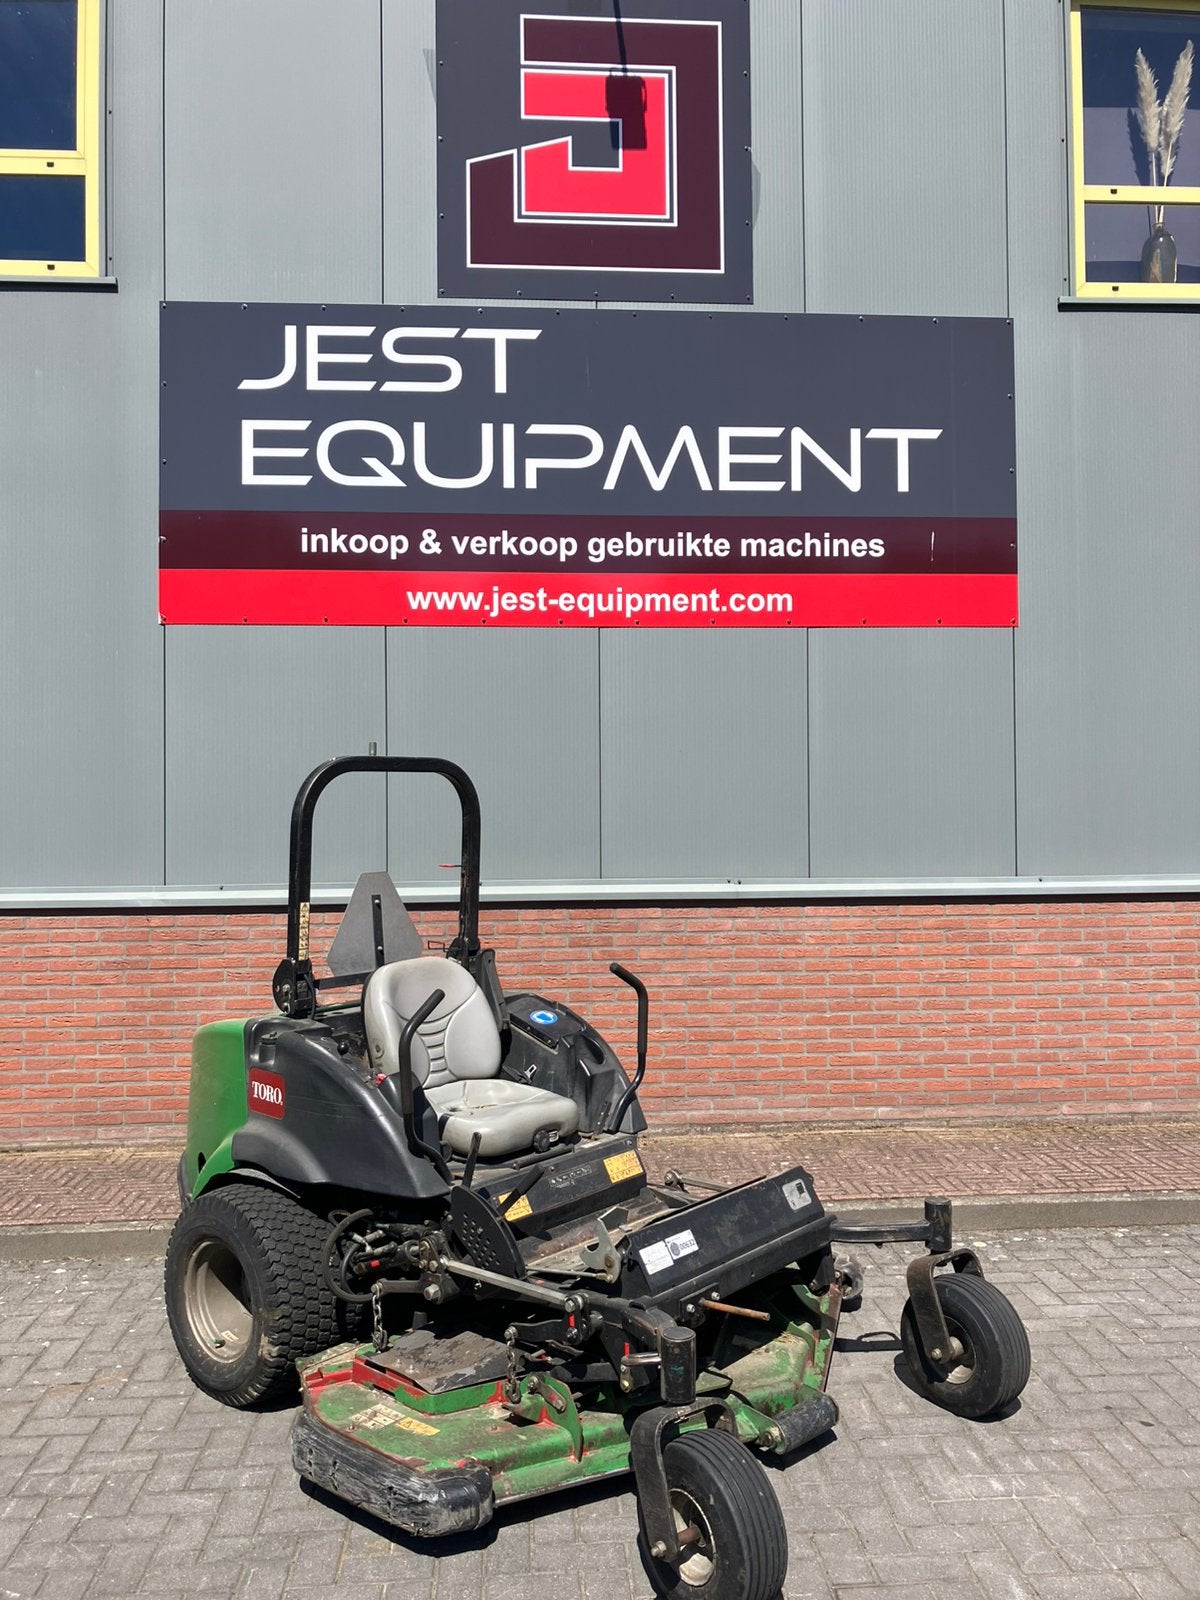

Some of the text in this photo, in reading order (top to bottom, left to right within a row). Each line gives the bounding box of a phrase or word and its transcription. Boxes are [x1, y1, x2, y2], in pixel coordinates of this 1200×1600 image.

[238, 325, 542, 393] JEST
[242, 420, 943, 493] EQUIPMENT
[301, 527, 885, 563] inkoop & verkoop gebruikte machines
[406, 586, 793, 618] www.jest-equipment.com
[251, 1080, 282, 1105] TORO
